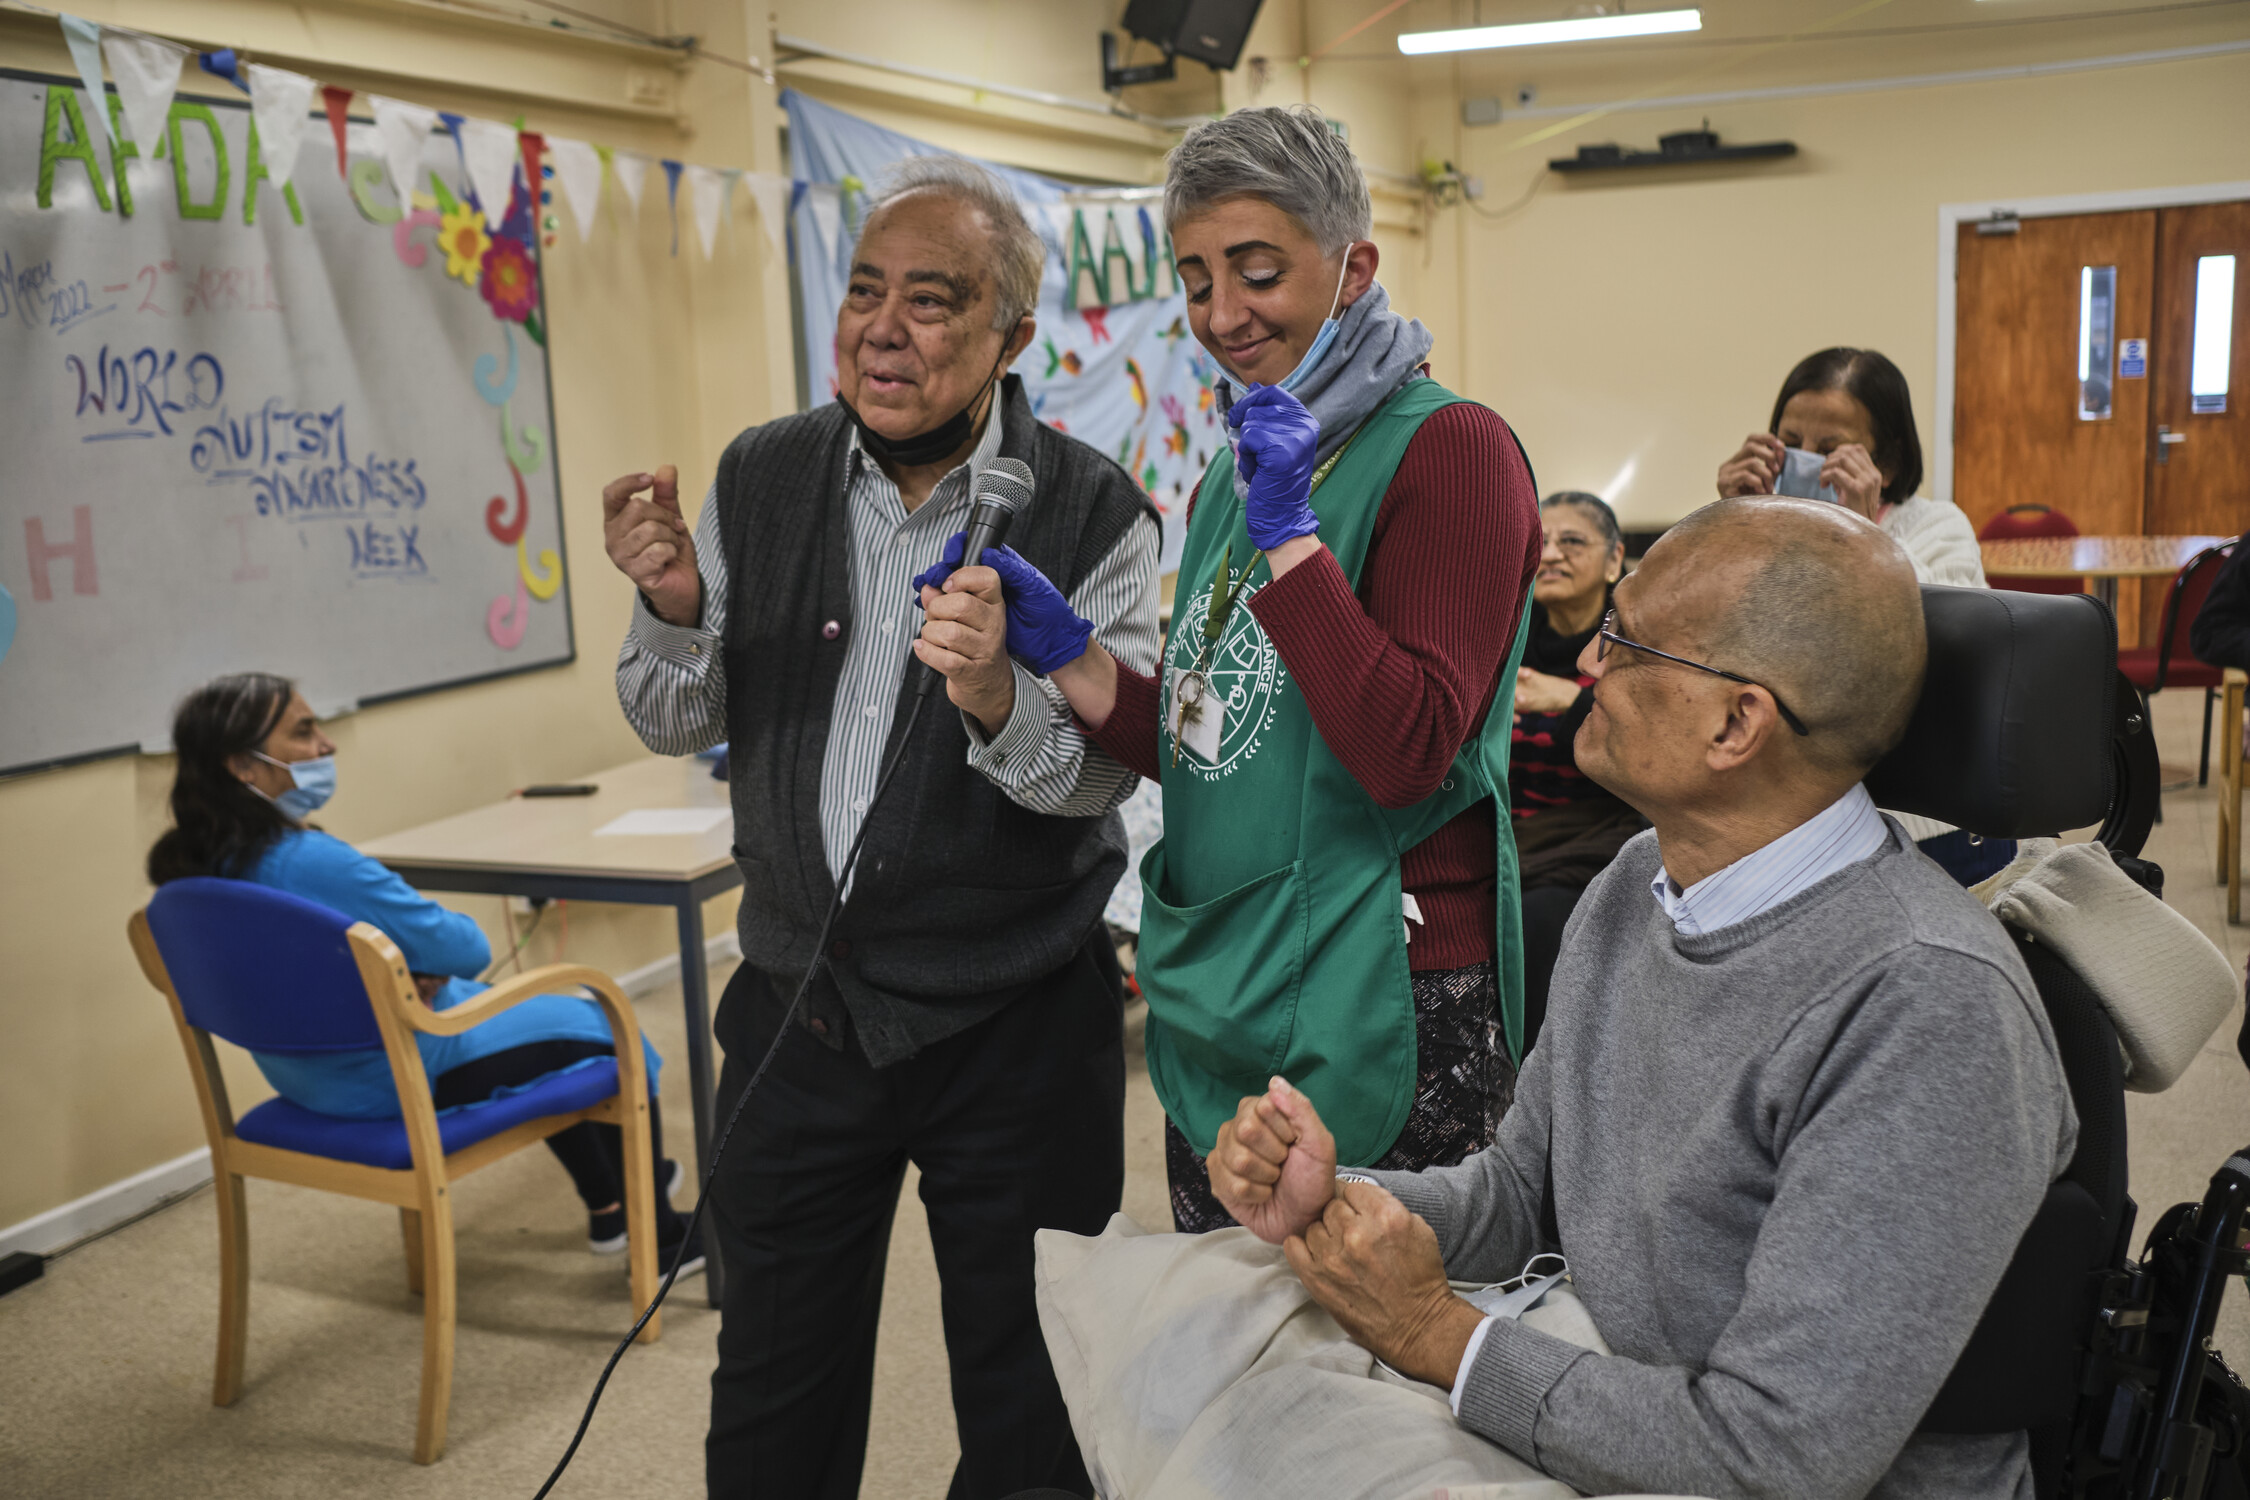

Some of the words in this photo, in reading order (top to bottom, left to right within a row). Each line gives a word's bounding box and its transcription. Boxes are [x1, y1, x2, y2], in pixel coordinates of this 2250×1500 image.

[66, 344, 224, 436] WORLD
[190, 396, 349, 473] AUTISM
[1257, 620, 1275, 694] LIANCE
